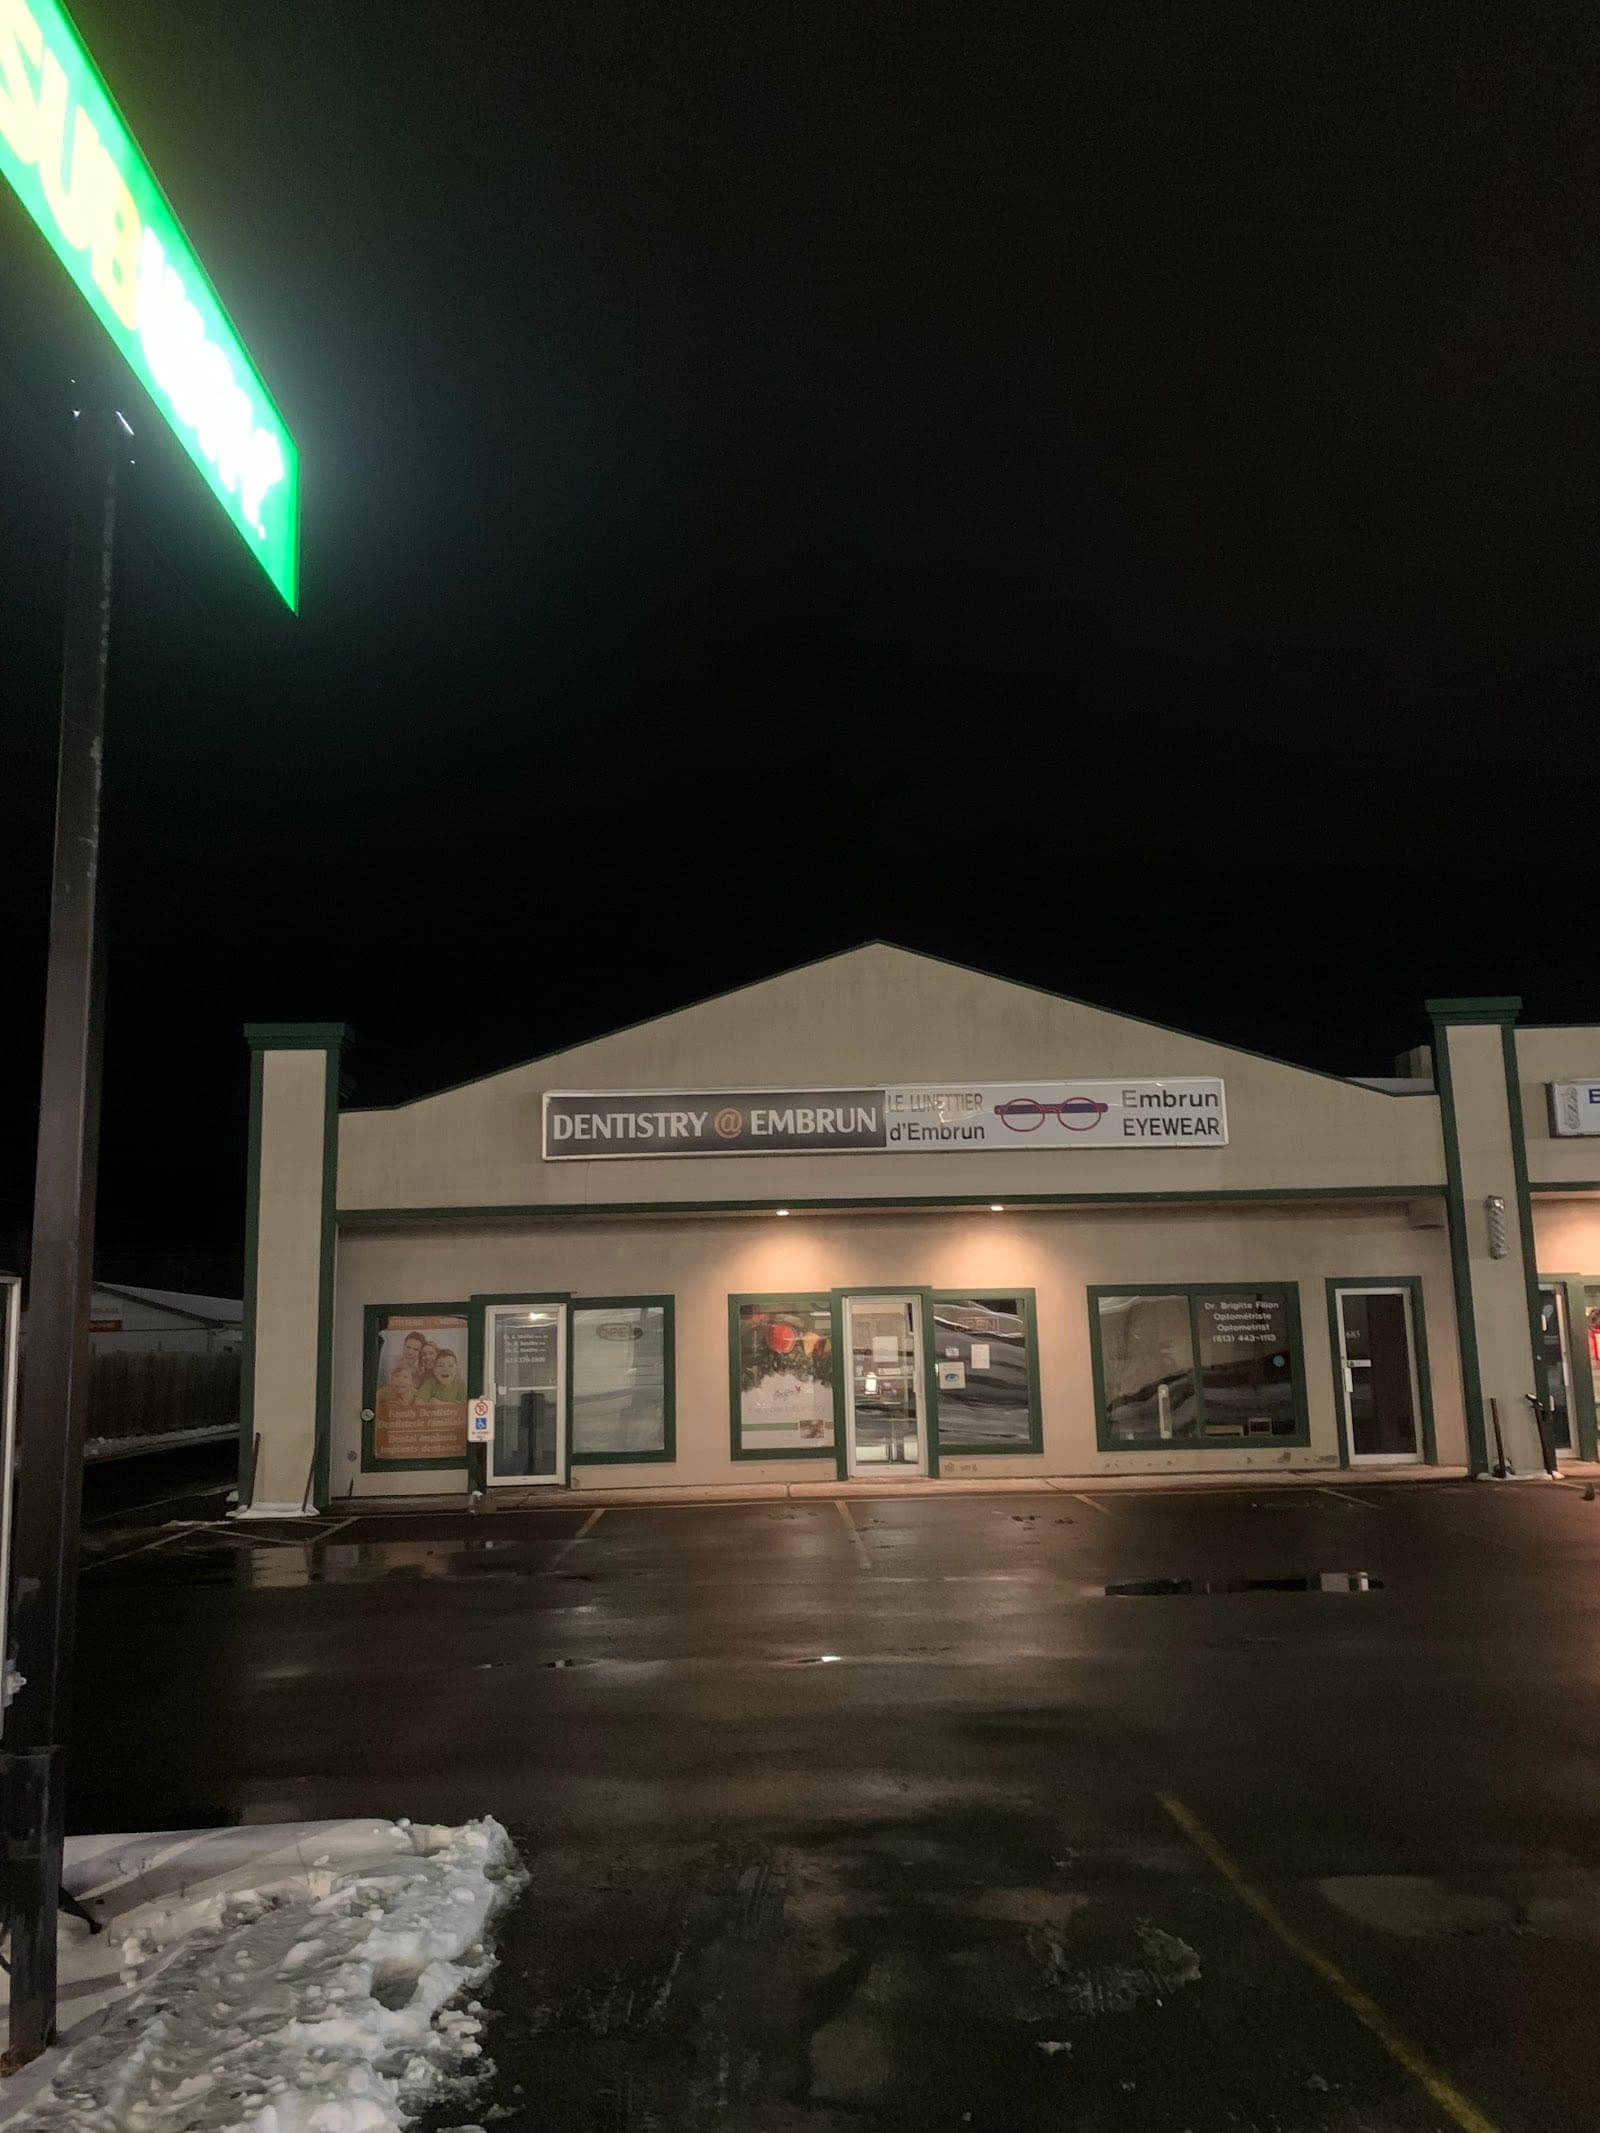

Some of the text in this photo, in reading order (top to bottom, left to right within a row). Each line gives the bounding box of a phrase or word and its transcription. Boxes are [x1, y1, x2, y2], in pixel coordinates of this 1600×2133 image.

[888, 1093, 984, 1112] LE LUNETTIER
[1122, 1089, 1219, 1108] Embrun
[553, 1107, 877, 1140] DENTISTRY @ EMBRUN
[890, 1122, 985, 1141] d'Embrun
[1123, 1117, 1220, 1136] EYEWEAR
